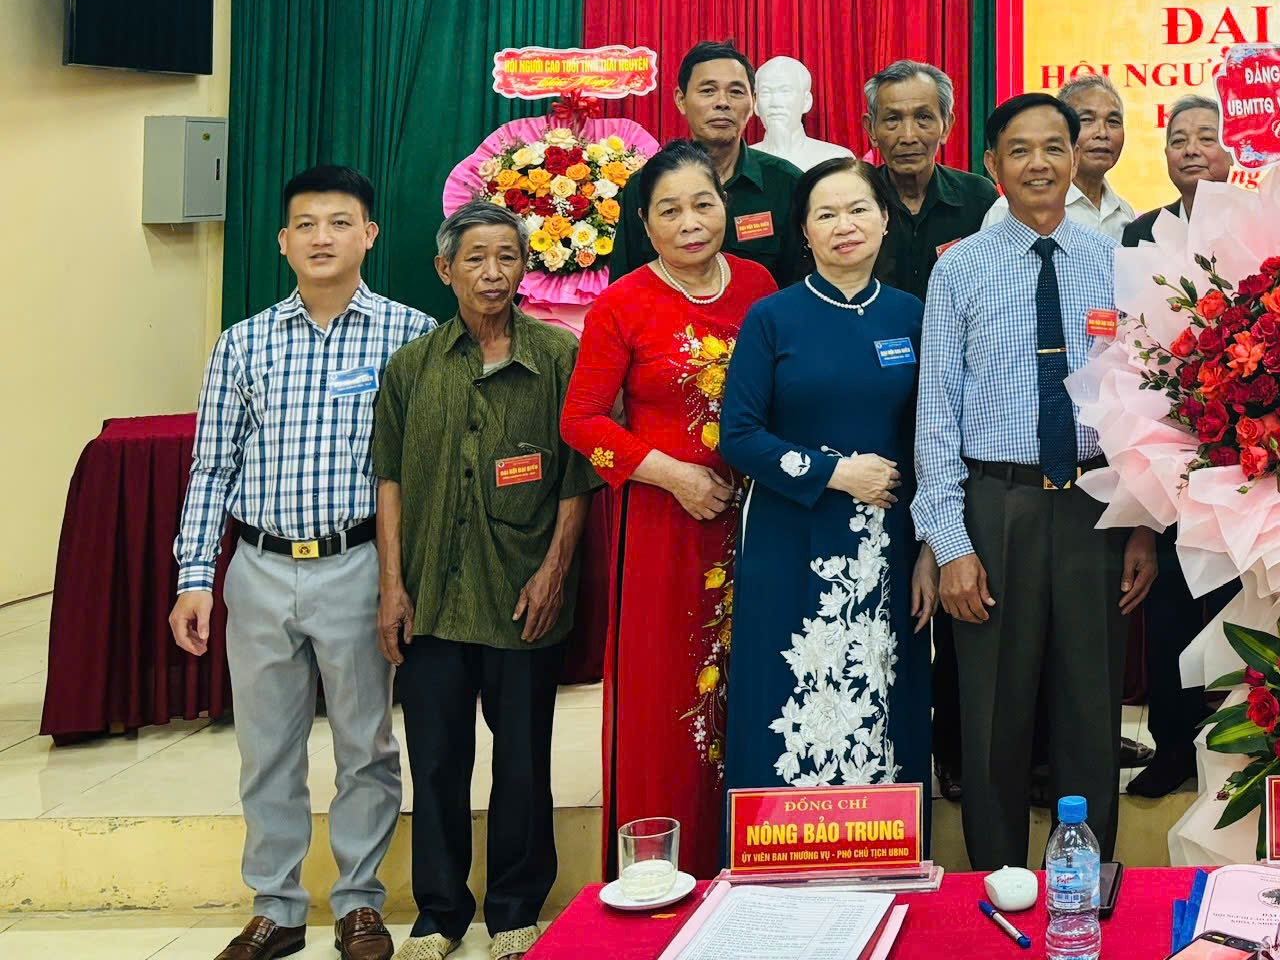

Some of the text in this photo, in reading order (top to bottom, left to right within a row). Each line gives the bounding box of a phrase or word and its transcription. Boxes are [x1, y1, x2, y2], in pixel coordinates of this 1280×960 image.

[545, 59, 561, 72] CAO
[1244, 61, 1280, 84] ĐẢNG
[1227, 97, 1275, 117] UBMTTQ
[784, 796, 868, 812] ĐỒNG CHÍ
[746, 816, 905, 846] NÔNG BẢO TRUNG
[753, 852, 771, 862] VIÊN
[772, 852, 788, 861] BAN
[836, 848, 852, 859] PHÓ
[853, 846, 869, 858] CHỦ
[870, 848, 887, 859] TỊCH
[888, 847, 909, 857] UBND
